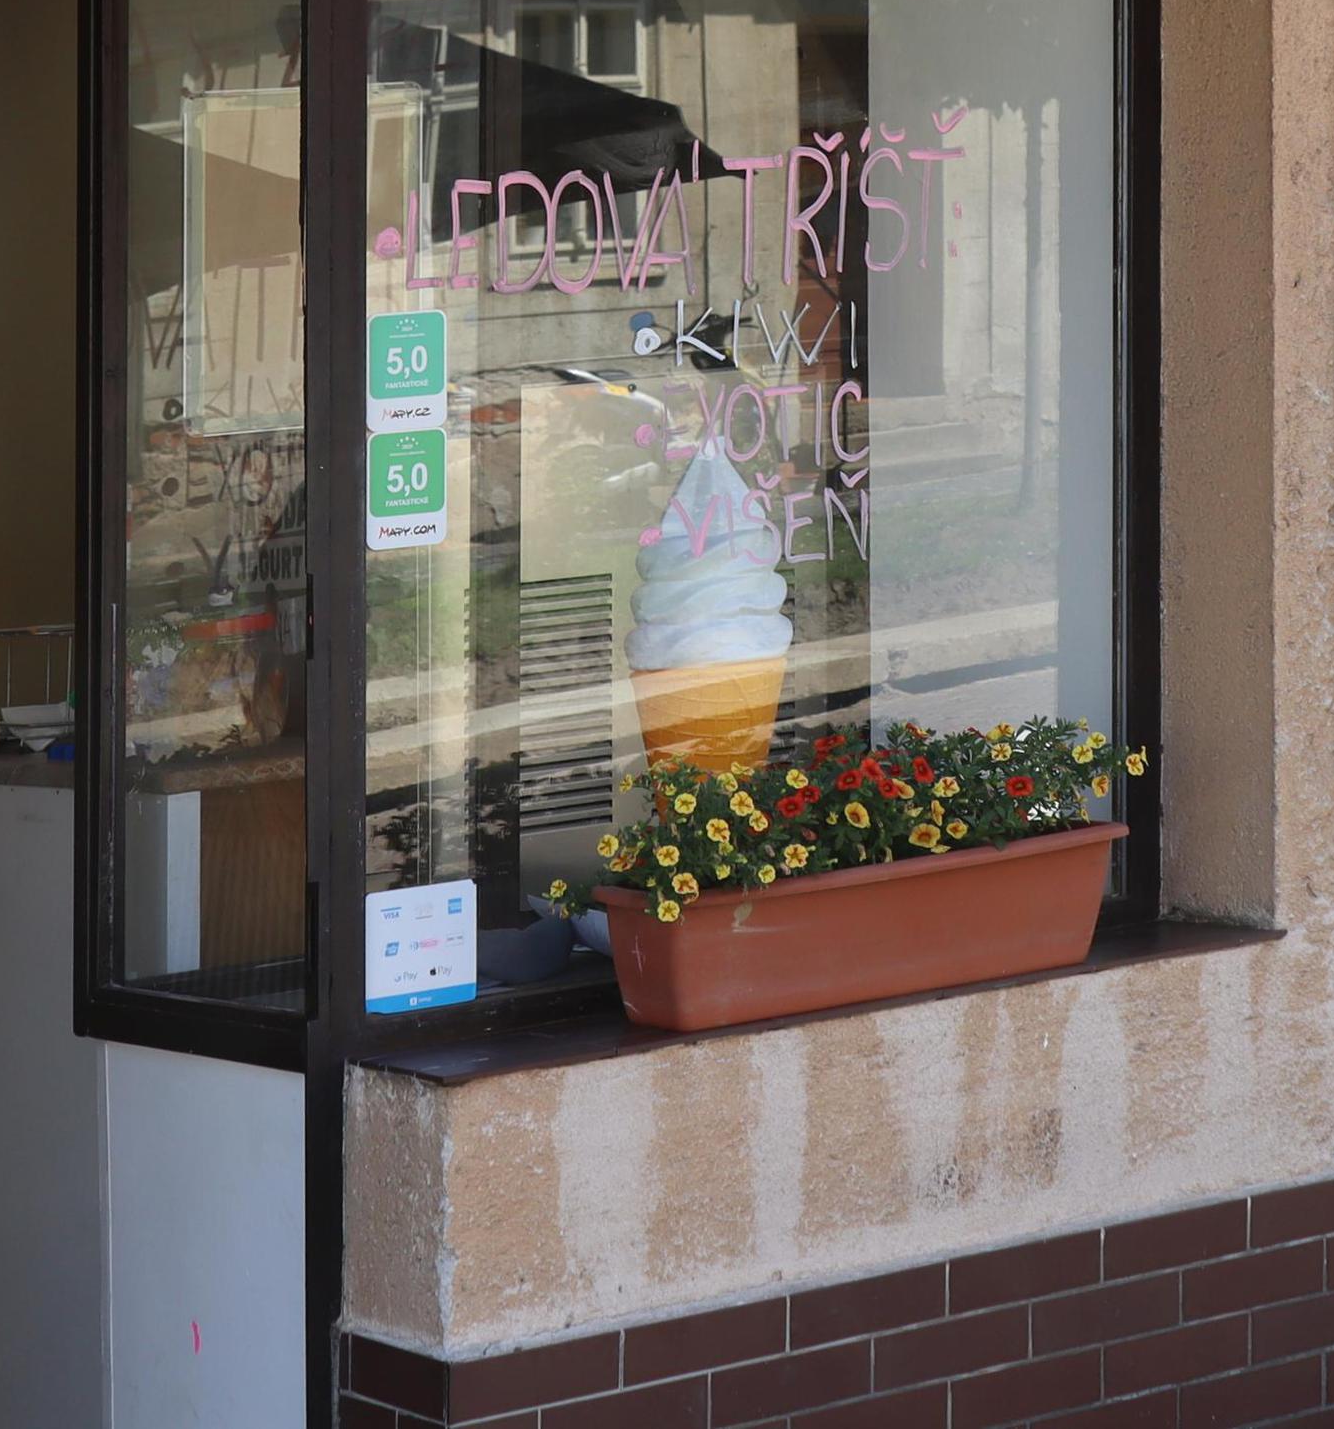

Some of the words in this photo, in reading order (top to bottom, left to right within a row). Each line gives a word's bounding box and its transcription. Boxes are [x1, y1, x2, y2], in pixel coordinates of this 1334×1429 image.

[406, 138, 699, 296] LEDOVÁ
[387, 345, 428, 379] 5,0
[676, 299, 858, 369] KIWI
[664, 380, 869, 467] EXOTIC
[387, 462, 428, 497] 5,0
[670, 468, 870, 566] VIŠEŇ
[383, 911, 400, 920] VISA
